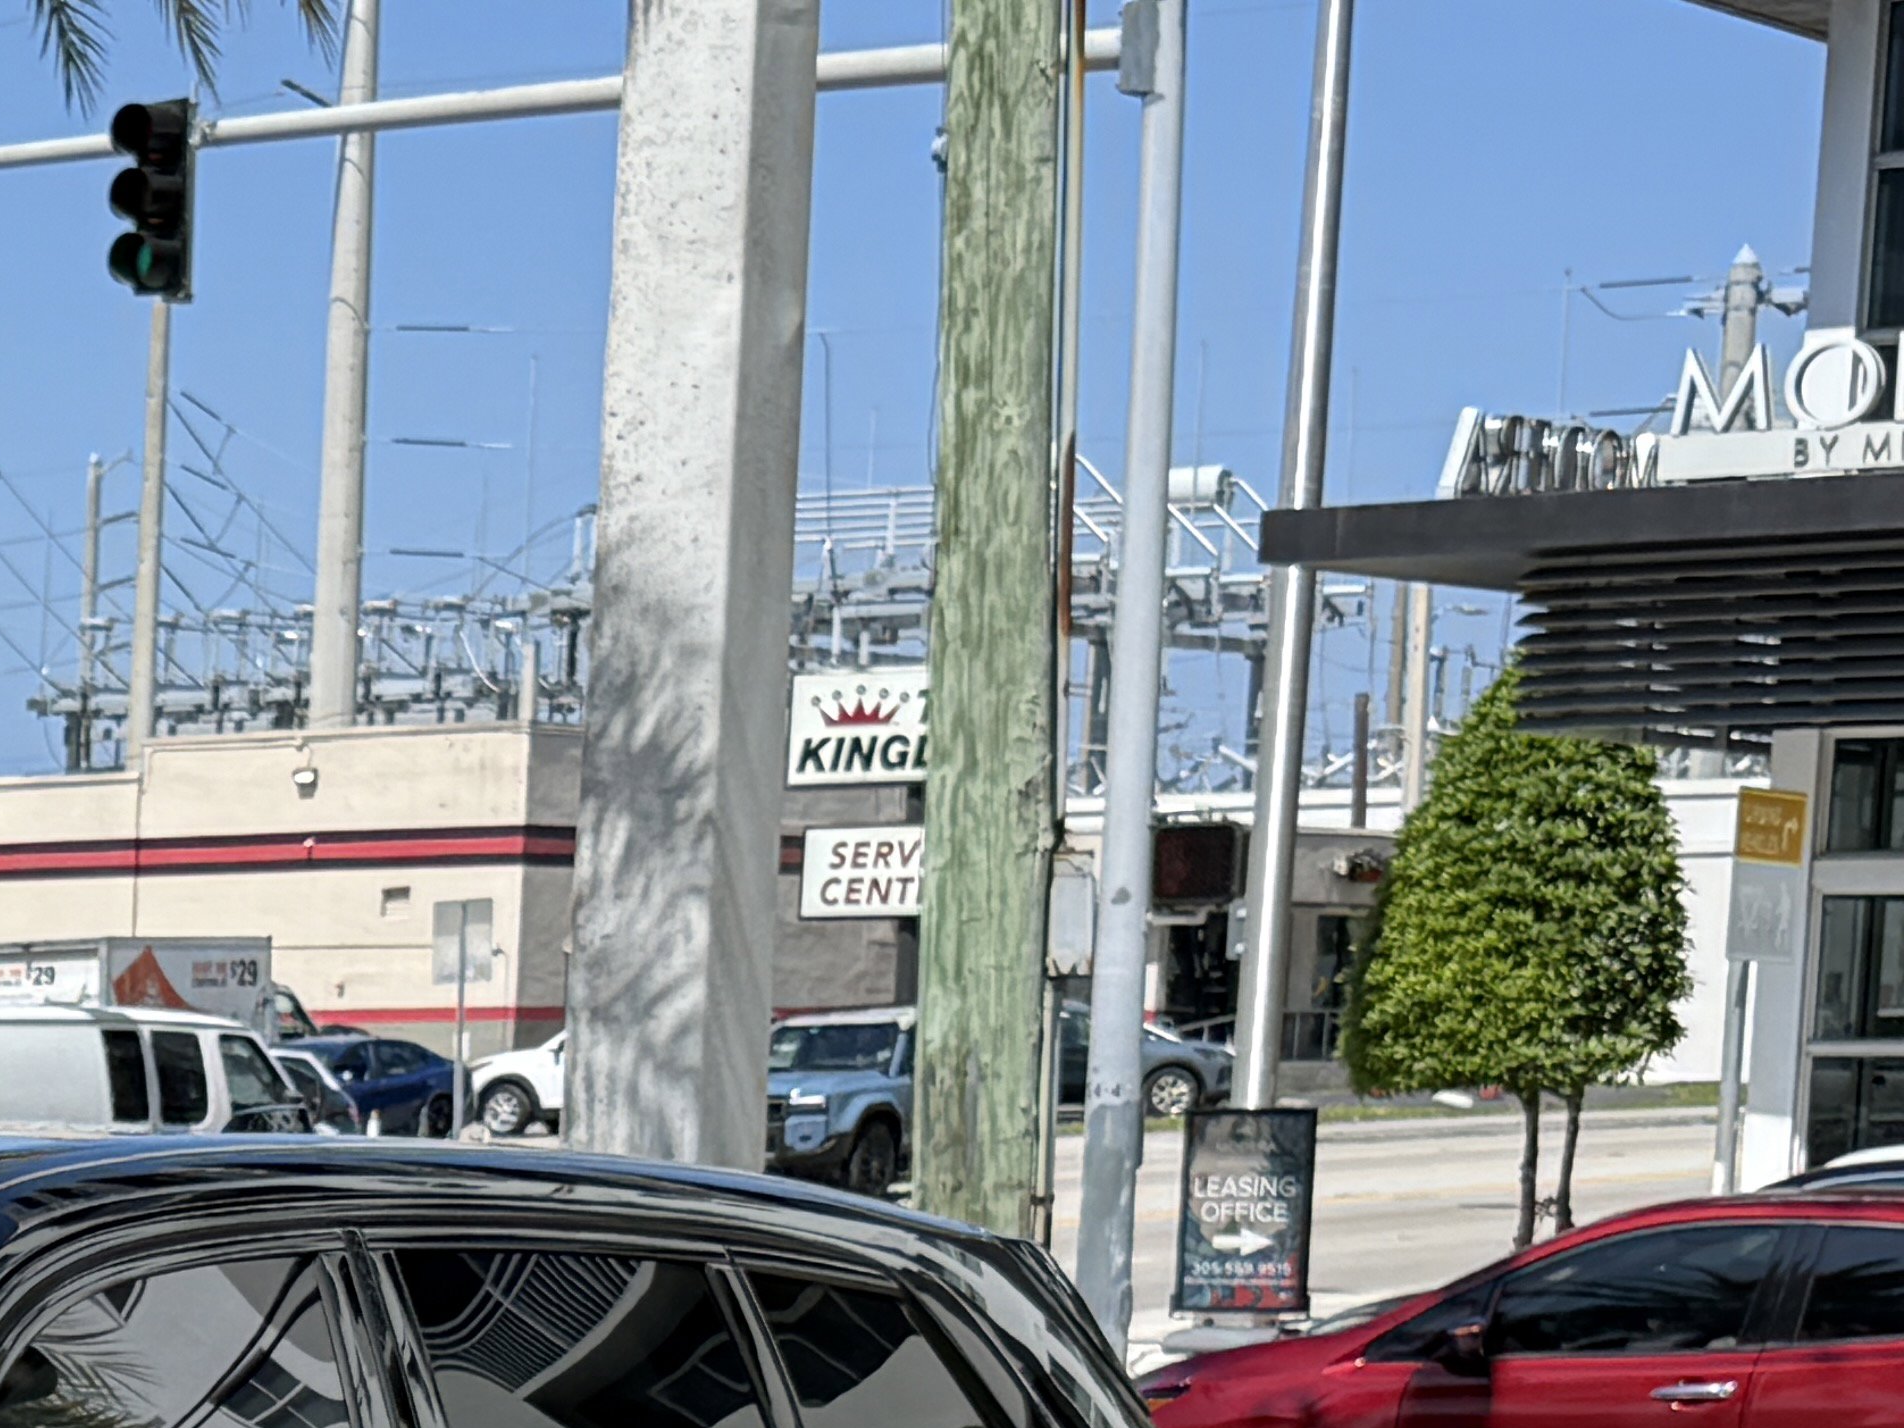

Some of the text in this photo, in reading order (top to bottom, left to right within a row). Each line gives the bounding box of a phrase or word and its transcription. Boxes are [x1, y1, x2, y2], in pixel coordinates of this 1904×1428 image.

[1670, 338, 1904, 434] MO
[1793, 432, 1904, 467] BY M
[820, 877, 921, 906] CENT
[230, 958, 258, 987] $29
[1194, 1175, 1296, 1198] LEASING
[1200, 1201, 1289, 1223] OFFICE
